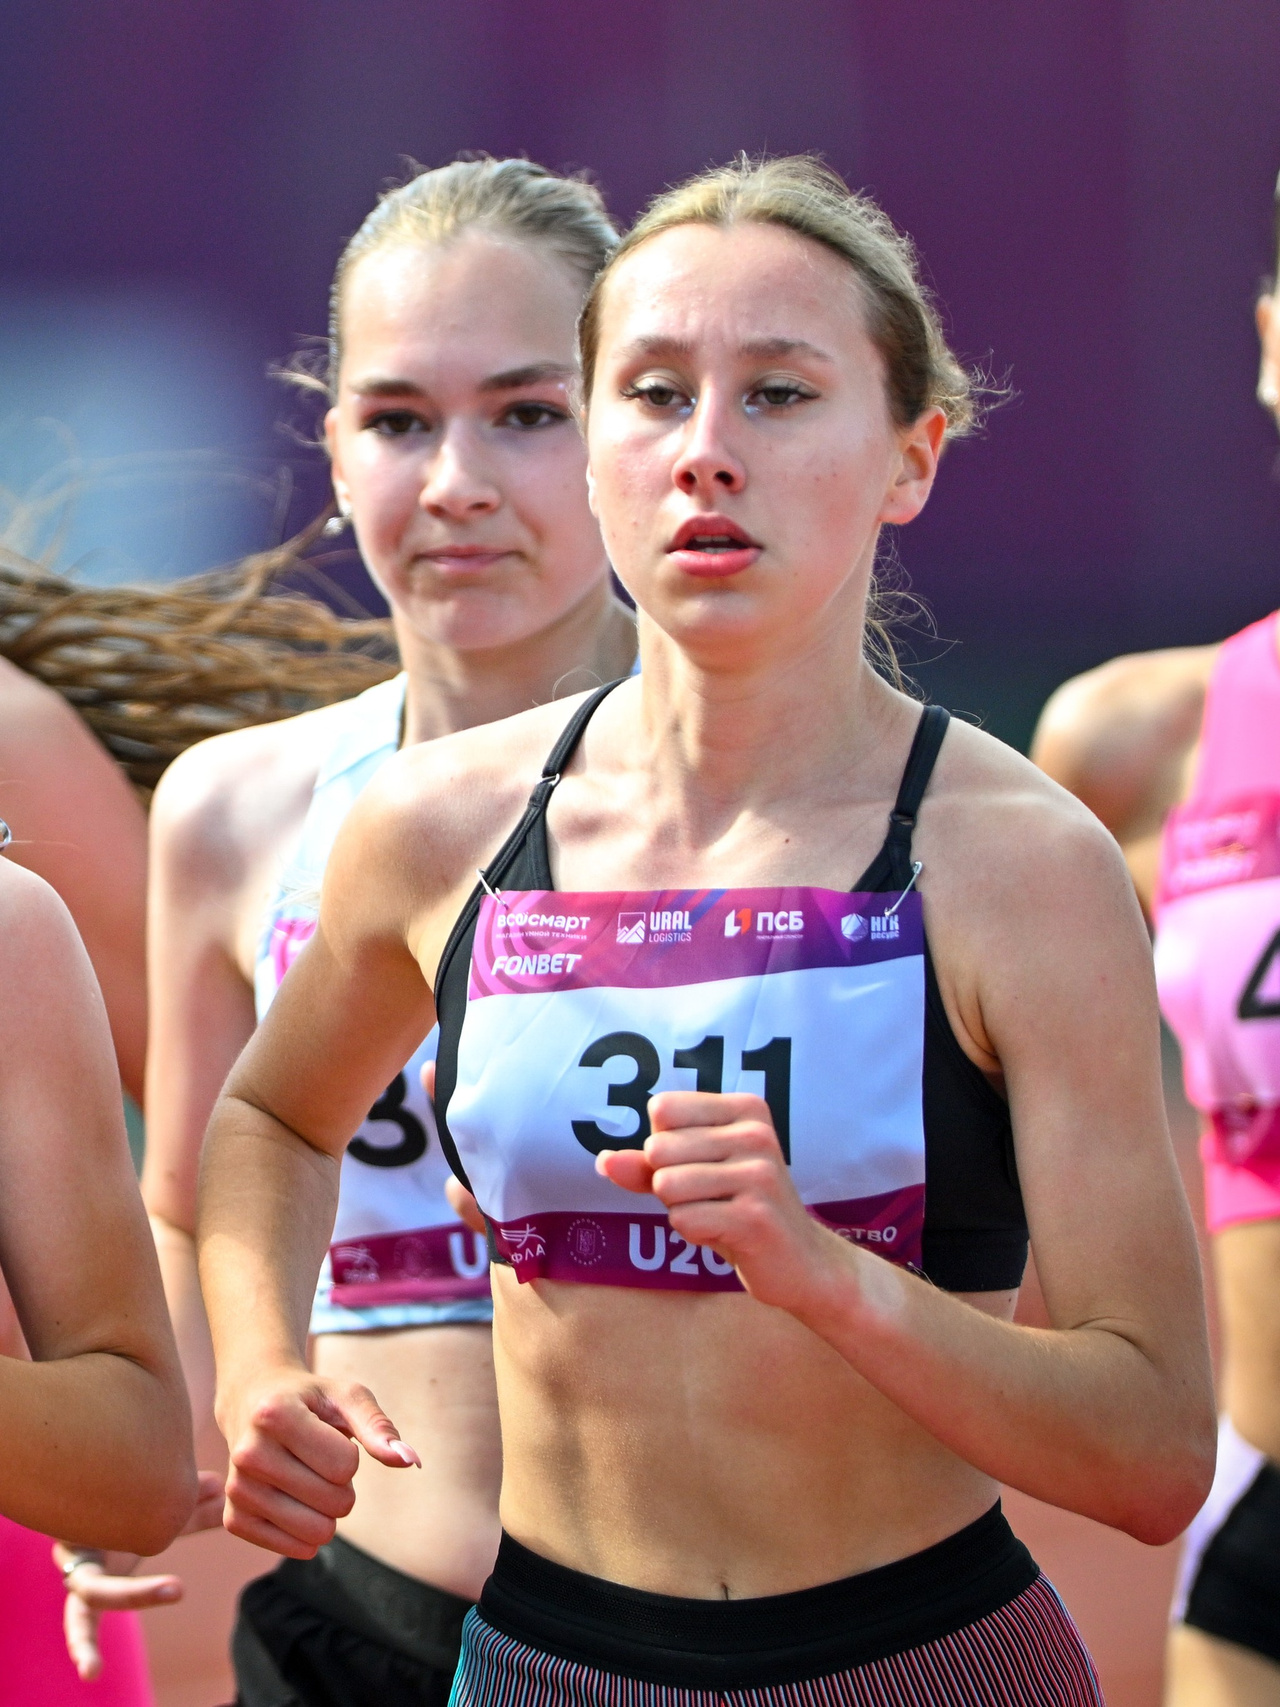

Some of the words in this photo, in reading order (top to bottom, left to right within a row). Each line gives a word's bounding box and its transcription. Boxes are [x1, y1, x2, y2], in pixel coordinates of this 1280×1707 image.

[649, 911, 692, 931] URAL
[757, 911, 804, 931] ПСБ
[649, 932, 692, 943] LOGISTICS
[491, 953, 582, 976] FONBET
[509, 1243, 546, 1263] ФЛА
